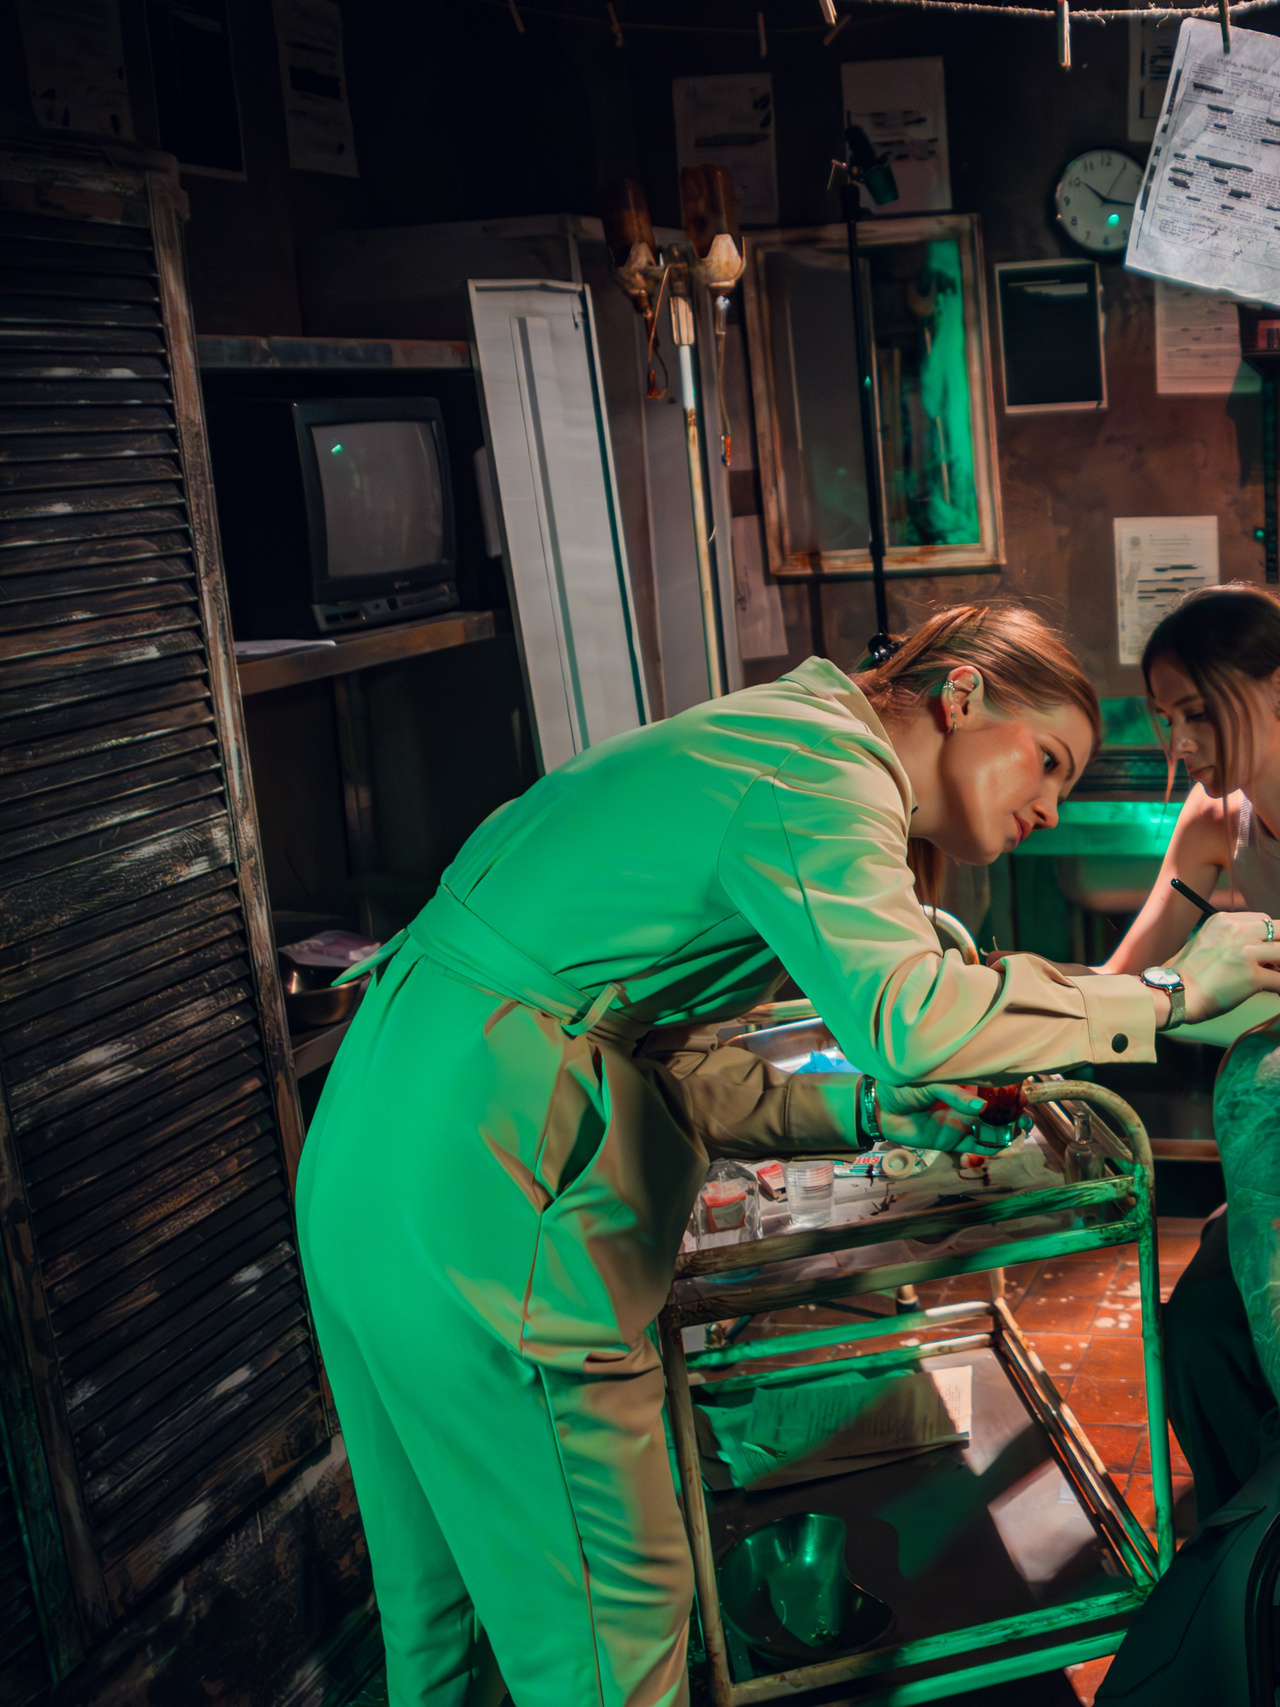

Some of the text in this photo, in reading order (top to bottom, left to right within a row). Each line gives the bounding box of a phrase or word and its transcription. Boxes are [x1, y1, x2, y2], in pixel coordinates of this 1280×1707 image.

[1217, 58, 1239, 68] FEDERAL
[1240, 64, 1261, 74] BUREAU
[1101, 154, 1111, 166] 12
[1084, 160, 1093, 172] 11
[1069, 176, 1081, 187] 10
[1064, 196, 1070, 206] 9
[1071, 215, 1077, 226] 8
[1085, 231, 1091, 240] 7
[1103, 236, 1109, 246] 6
